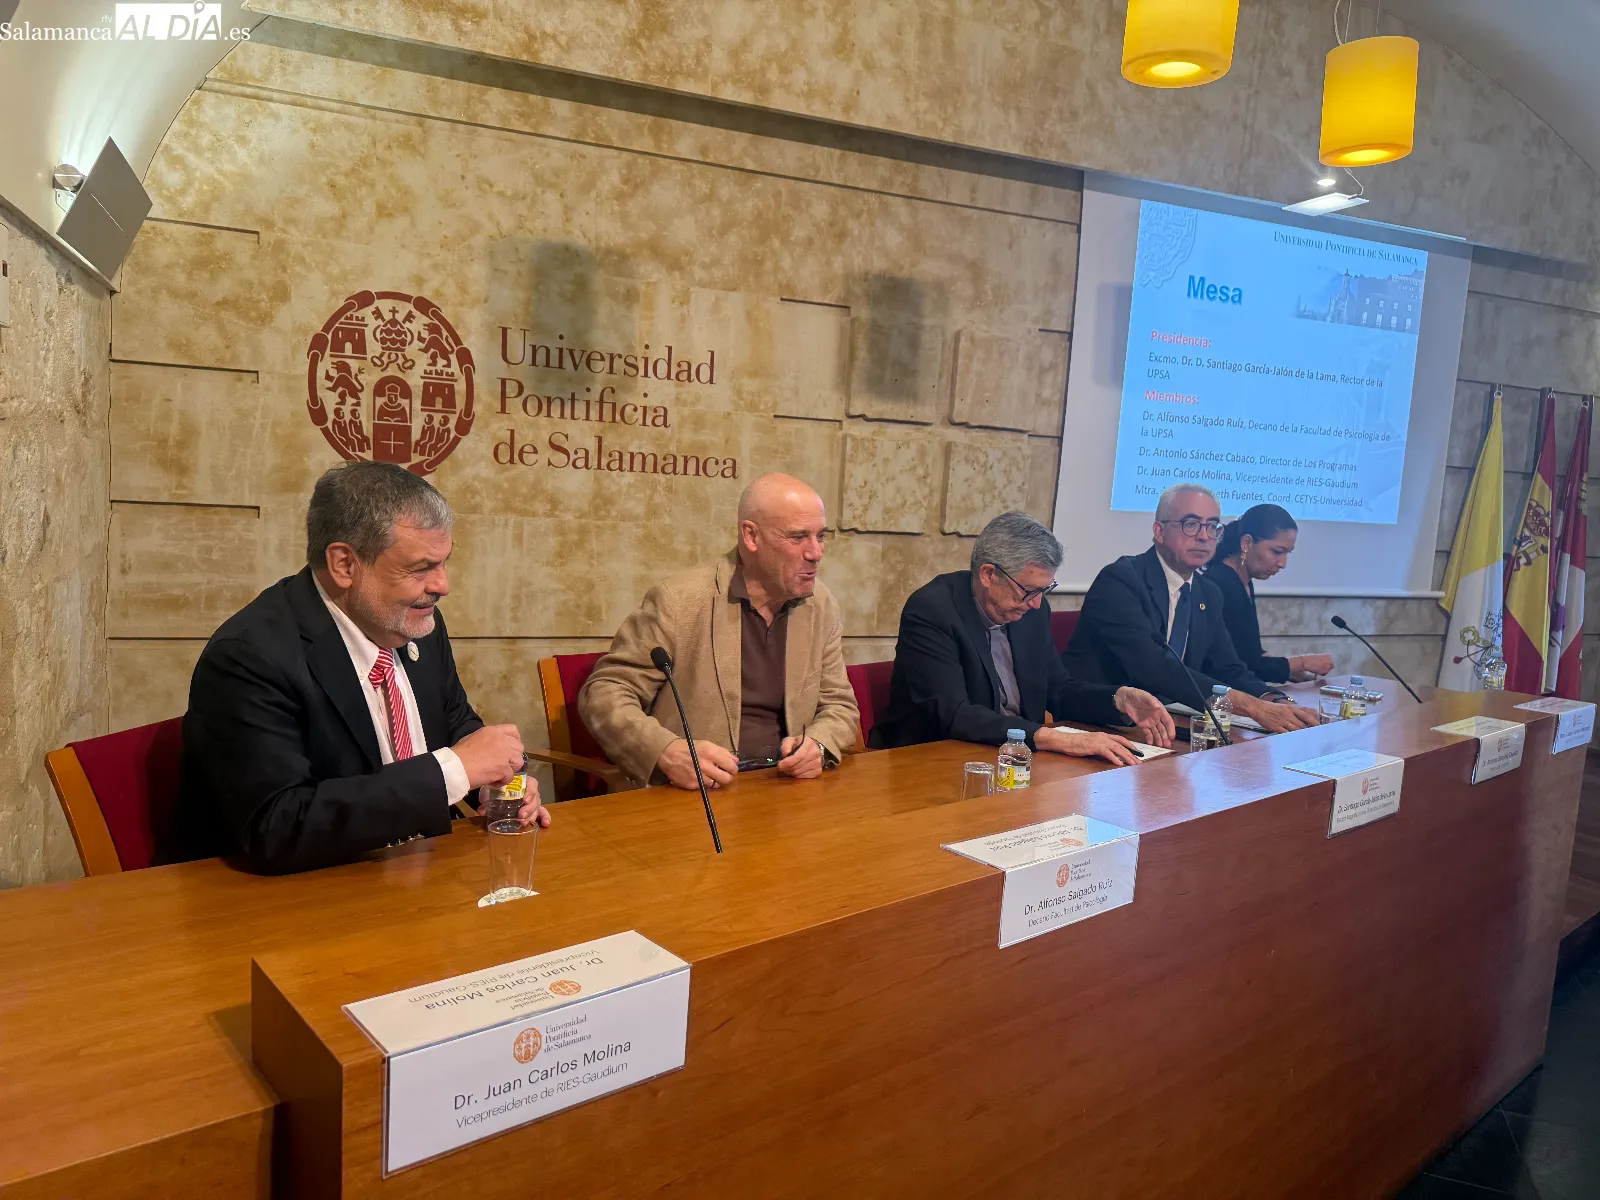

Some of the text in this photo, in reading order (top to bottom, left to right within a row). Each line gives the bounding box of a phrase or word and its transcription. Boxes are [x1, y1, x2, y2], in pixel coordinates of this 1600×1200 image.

[1186, 274, 1243, 305] Mesa
[497, 325, 717, 385] Universidad
[1151, 330, 1213, 349] Presidencia:
[1147, 368, 1171, 380] UPSA
[1148, 352, 1383, 388] Excmo. Dr. D. Santiago García-Jalón de la Lama, Rector de la
[496, 377, 671, 428] Pontificia
[1144, 389, 1200, 405] Miembros:
[1140, 427, 1174, 439] la UPSA
[1142, 410, 1154, 422] Dr.
[1156, 412, 1190, 424] Alfonso
[1191, 414, 1225, 428] Salgado
[1248, 420, 1278, 432] Decano
[1279, 422, 1290, 433] de
[1291, 423, 1298, 433] la
[1300, 425, 1332, 437] Facultad
[1332, 427, 1343, 438] de
[1381, 432, 1391, 442] de
[493, 428, 739, 479] de Salamanca
[1139, 447, 1357, 473] Dr. Antonio Sánchez Cabaco, Director de Los Programas
[1137, 466, 1359, 490] Dr. Juan Carlos Molina, Vicepresidente de RIES-Gaudium
[1135, 485, 1158, 496] Mtra.
[1231, 489, 1264, 502] Fuentes,
[1267, 492, 1292, 503] Coord.
[1024, 904, 1036, 915] Dr.
[1037, 895, 1066, 911] Alfonso
[1067, 884, 1097, 900] Salgado
[408, 949, 600, 1003] Vicepresidente de RIES-Gaudium
[425, 957, 604, 1010] Dr. Juan Carlos Molina
[544, 1014, 587, 1034] Universidad
[544, 1028, 578, 1044] Pontificia
[544, 1033, 592, 1053] de Salamanca
[454, 1041, 631, 1110] Dr. Juan Carlos Molina
[455, 1061, 628, 1128] Vicepresidente de RIES-Gaudium
